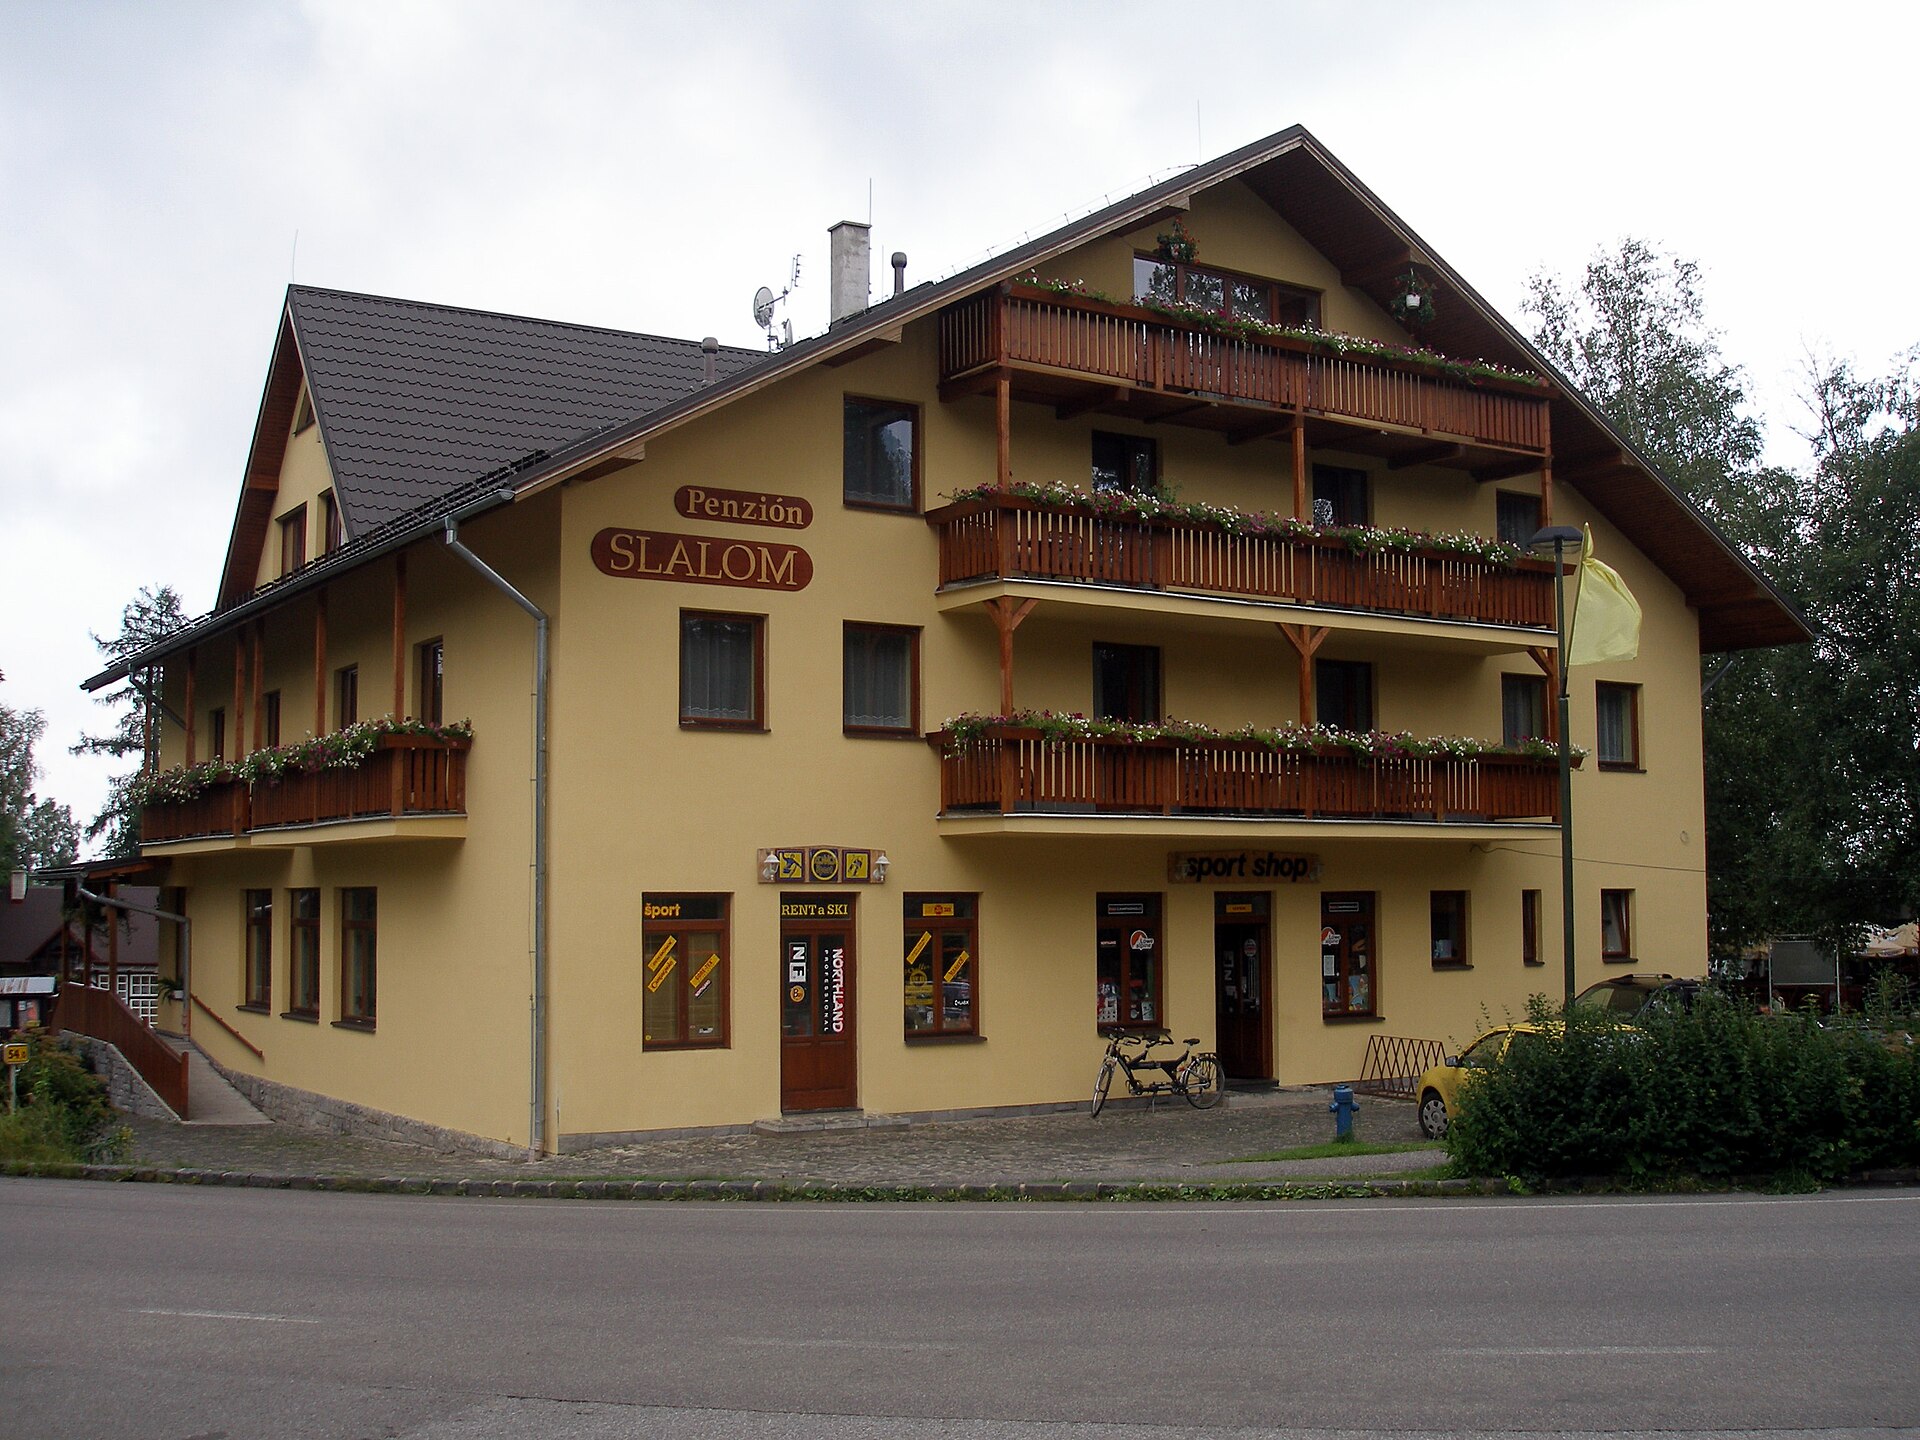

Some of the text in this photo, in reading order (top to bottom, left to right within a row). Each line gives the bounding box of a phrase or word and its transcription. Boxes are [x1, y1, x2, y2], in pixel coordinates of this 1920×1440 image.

[687, 488, 804, 525] Penzión
[610, 533, 798, 586] SLALOM
[1186, 852, 1308, 883] sport shop
[644, 903, 681, 919] šport
[781, 903, 849, 916] RENT a SKI
[832, 948, 844, 1033] NORTHLAND
